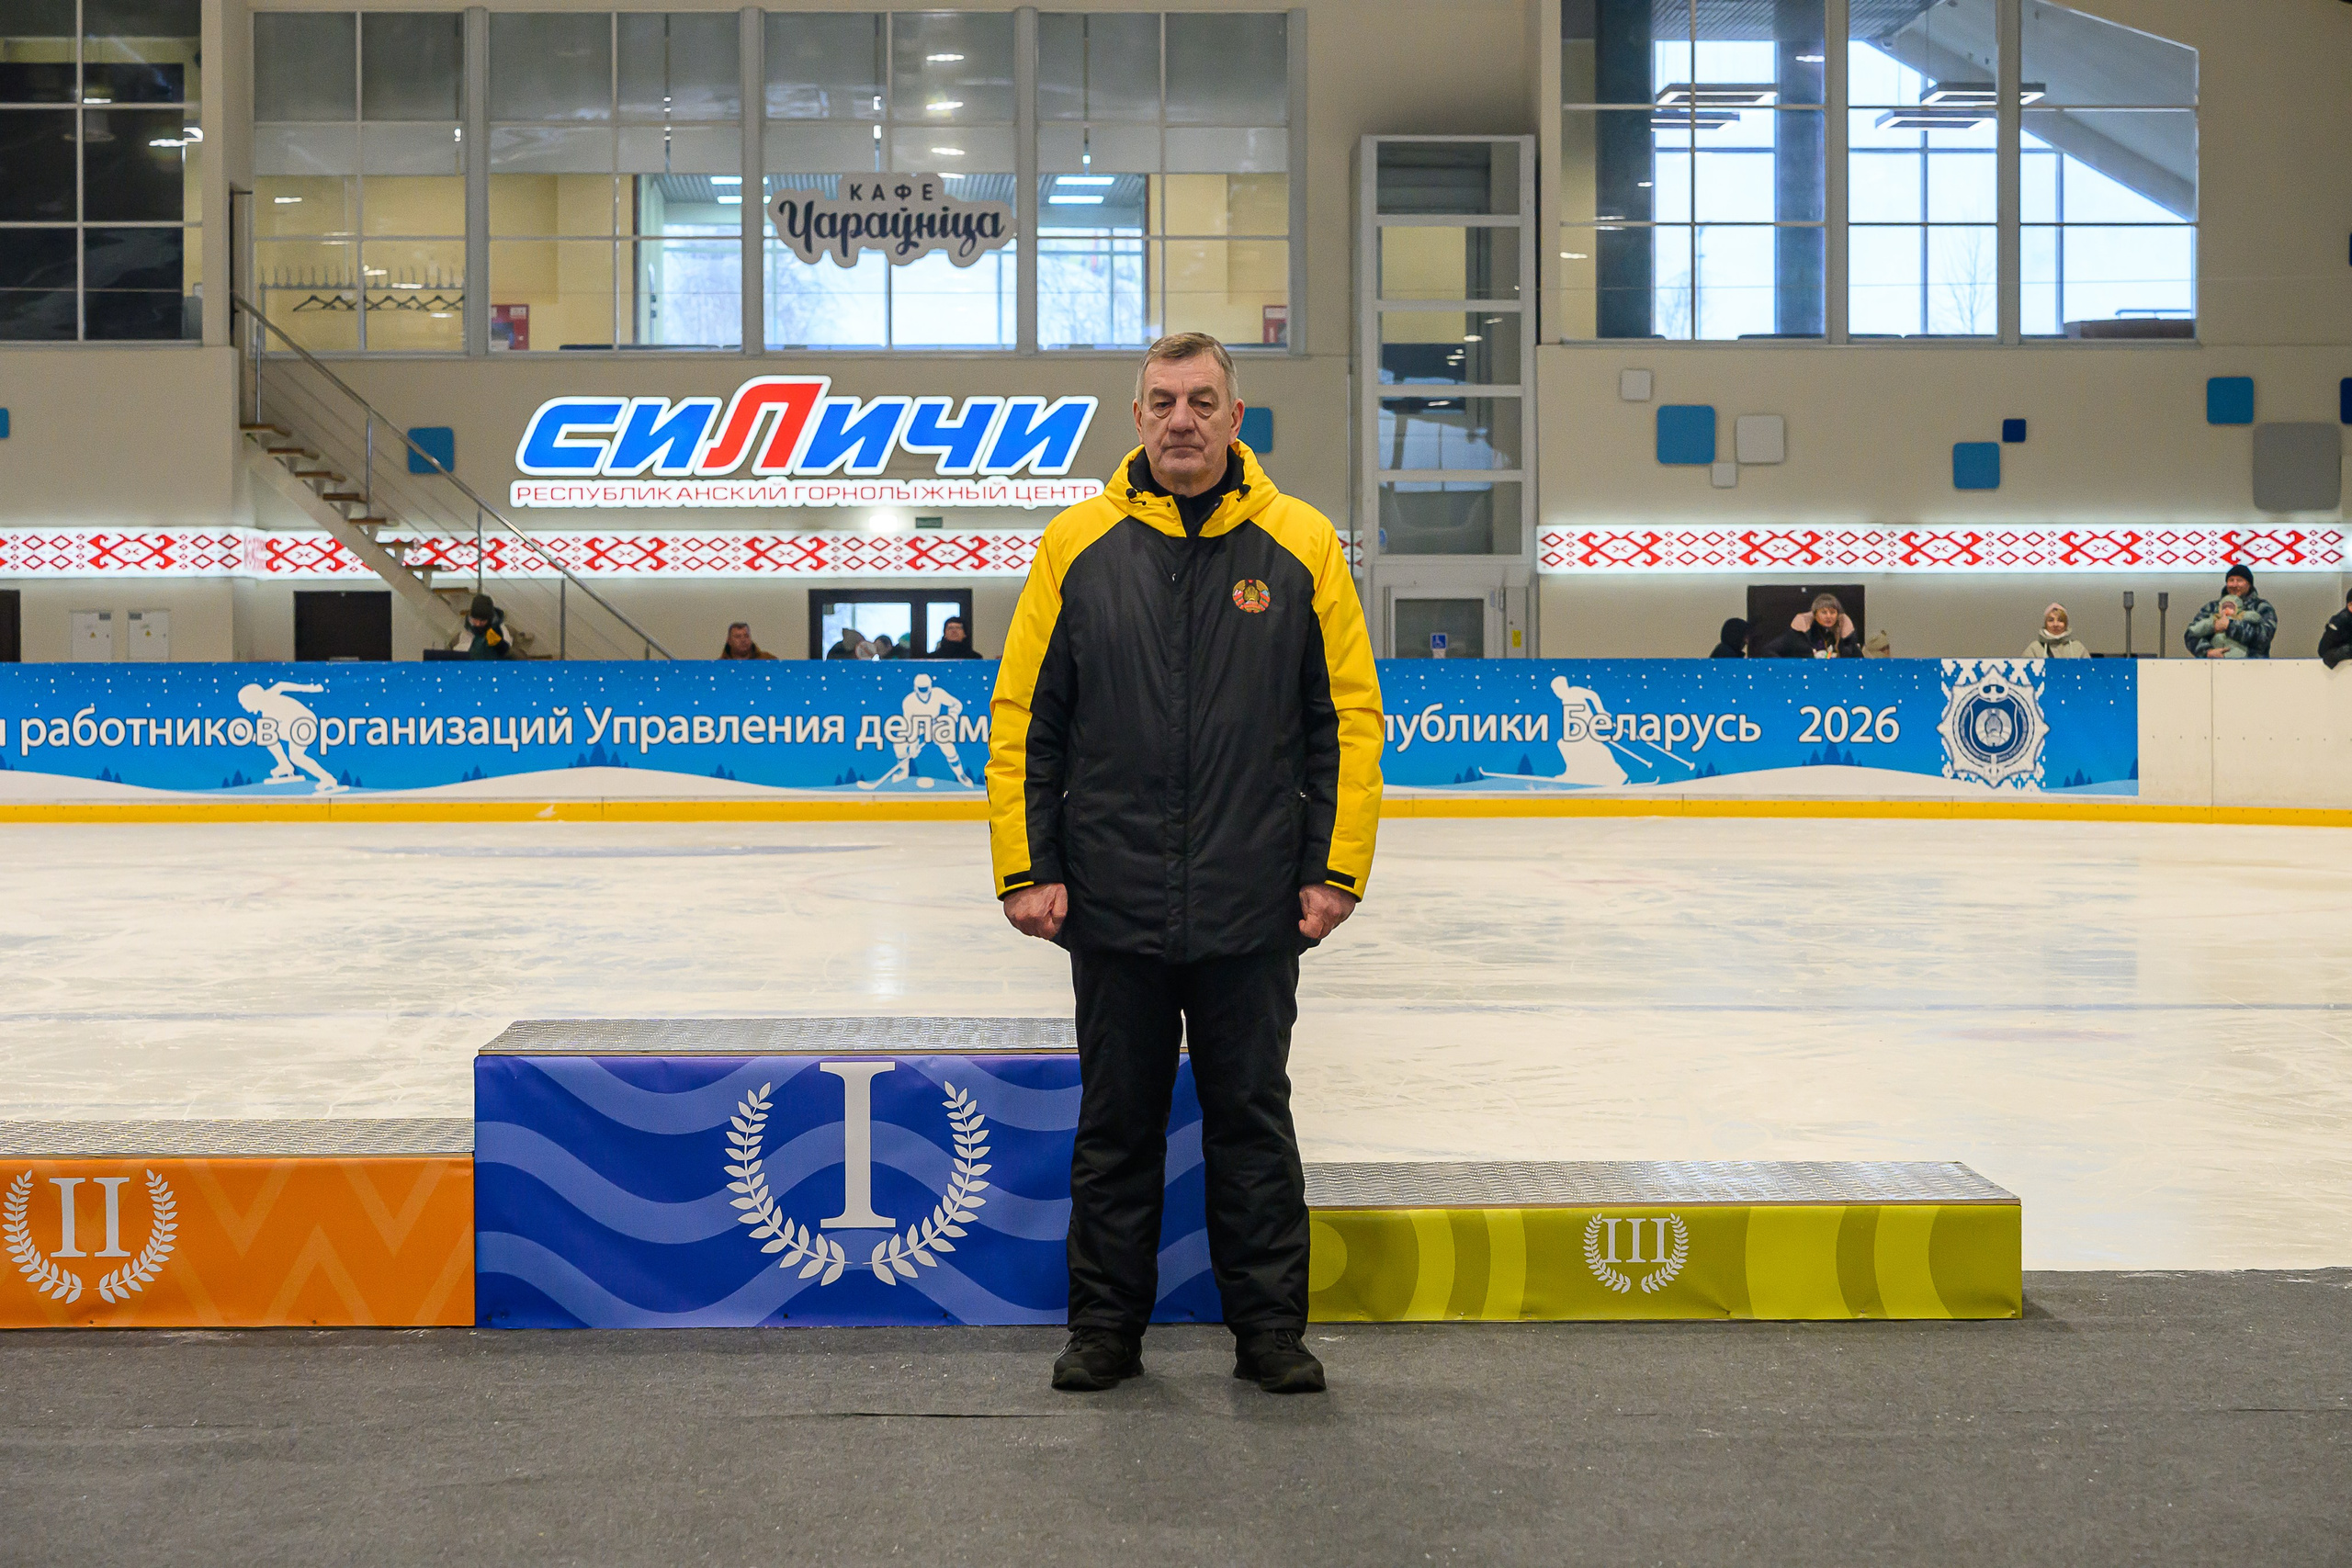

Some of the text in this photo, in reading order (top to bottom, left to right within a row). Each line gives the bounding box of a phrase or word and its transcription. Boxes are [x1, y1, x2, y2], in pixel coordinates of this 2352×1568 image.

[850, 184, 933, 201] КАФЕ
[516, 482, 1098, 504] РЕСПУБЛИКАНСКИЙ ГОРНОЛЫЖНЫЙ ЦЕНТР
[20, 706, 279, 757] работников
[290, 707, 574, 755] организаций
[585, 705, 844, 755] Управления
[1561, 704, 1761, 753] Беларусь
[1799, 705, 1900, 745] 2026
[820, 1062, 896, 1228] I
[49, 1177, 131, 1258] II
[1601, 1218, 1671, 1262] III
